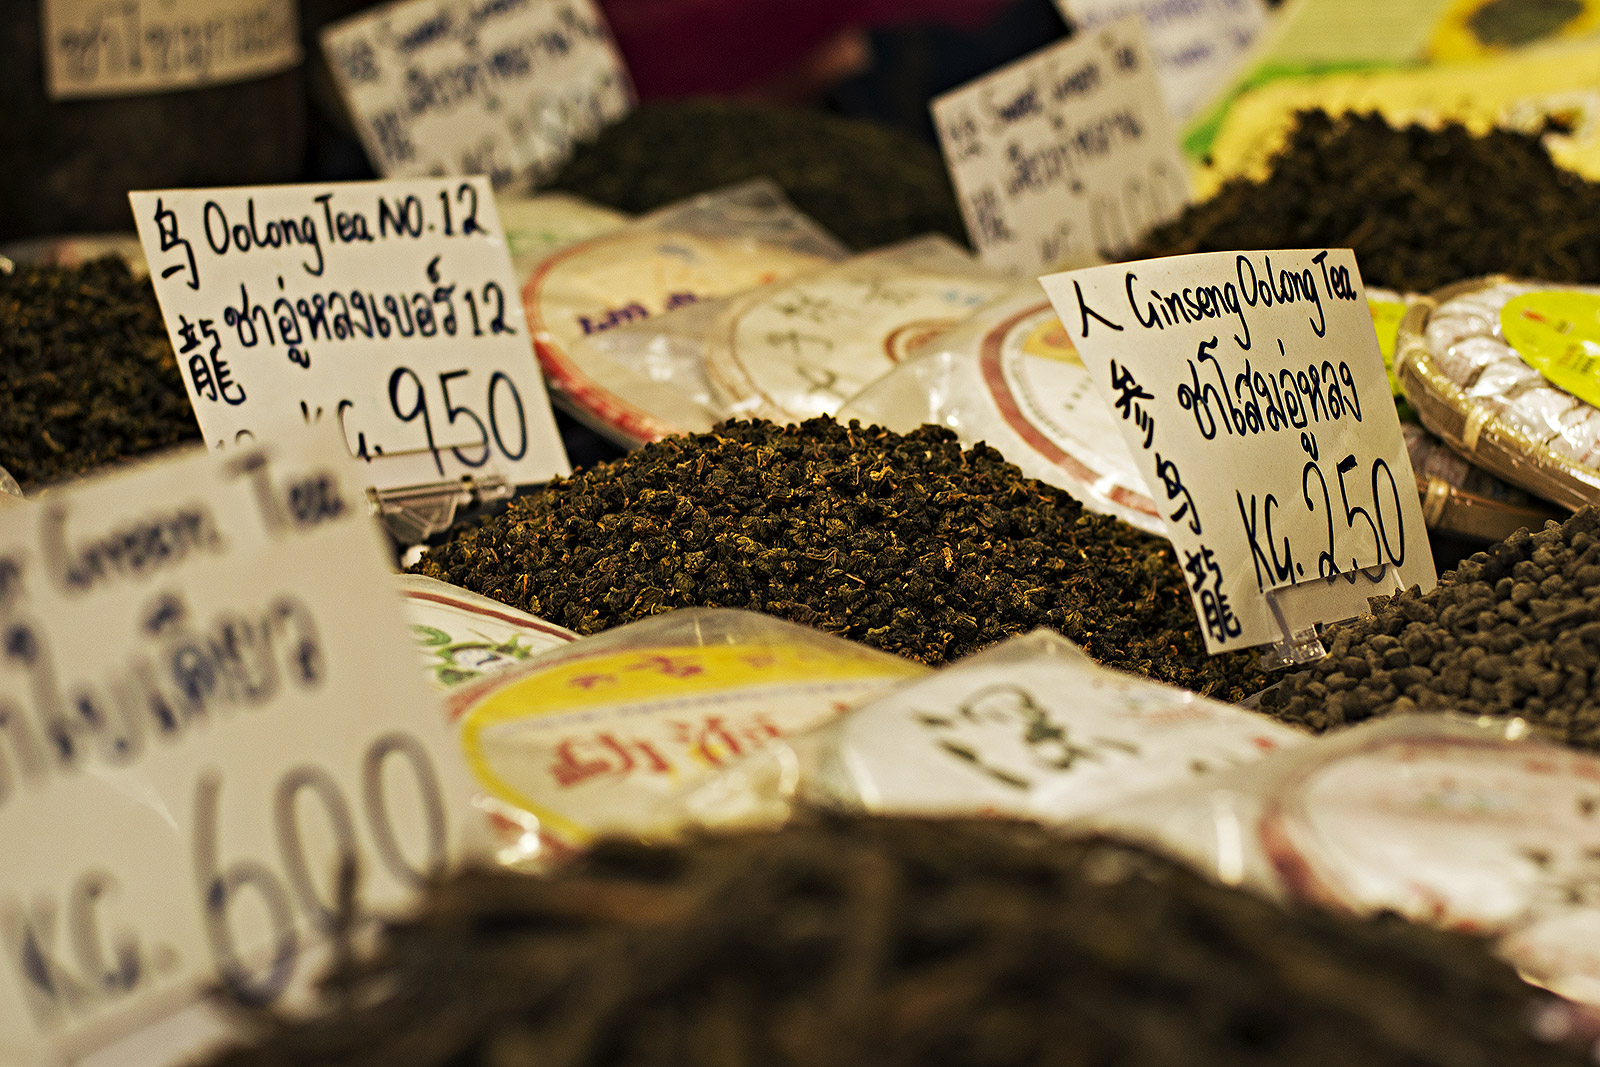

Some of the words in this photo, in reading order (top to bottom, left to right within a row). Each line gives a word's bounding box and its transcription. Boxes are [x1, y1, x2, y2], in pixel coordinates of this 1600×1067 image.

[203, 197, 325, 277] Oolong
[314, 193, 375, 243] Tea
[1125, 270, 1252, 351] Ginseng
[1235, 253, 1327, 339] Oolong
[1311, 250, 1358, 302] Tea
[387, 366, 530, 476] 950
[1234, 488, 1305, 595] KG.
[1302, 453, 1406, 586] 250
[189, 726, 450, 1012] 600
